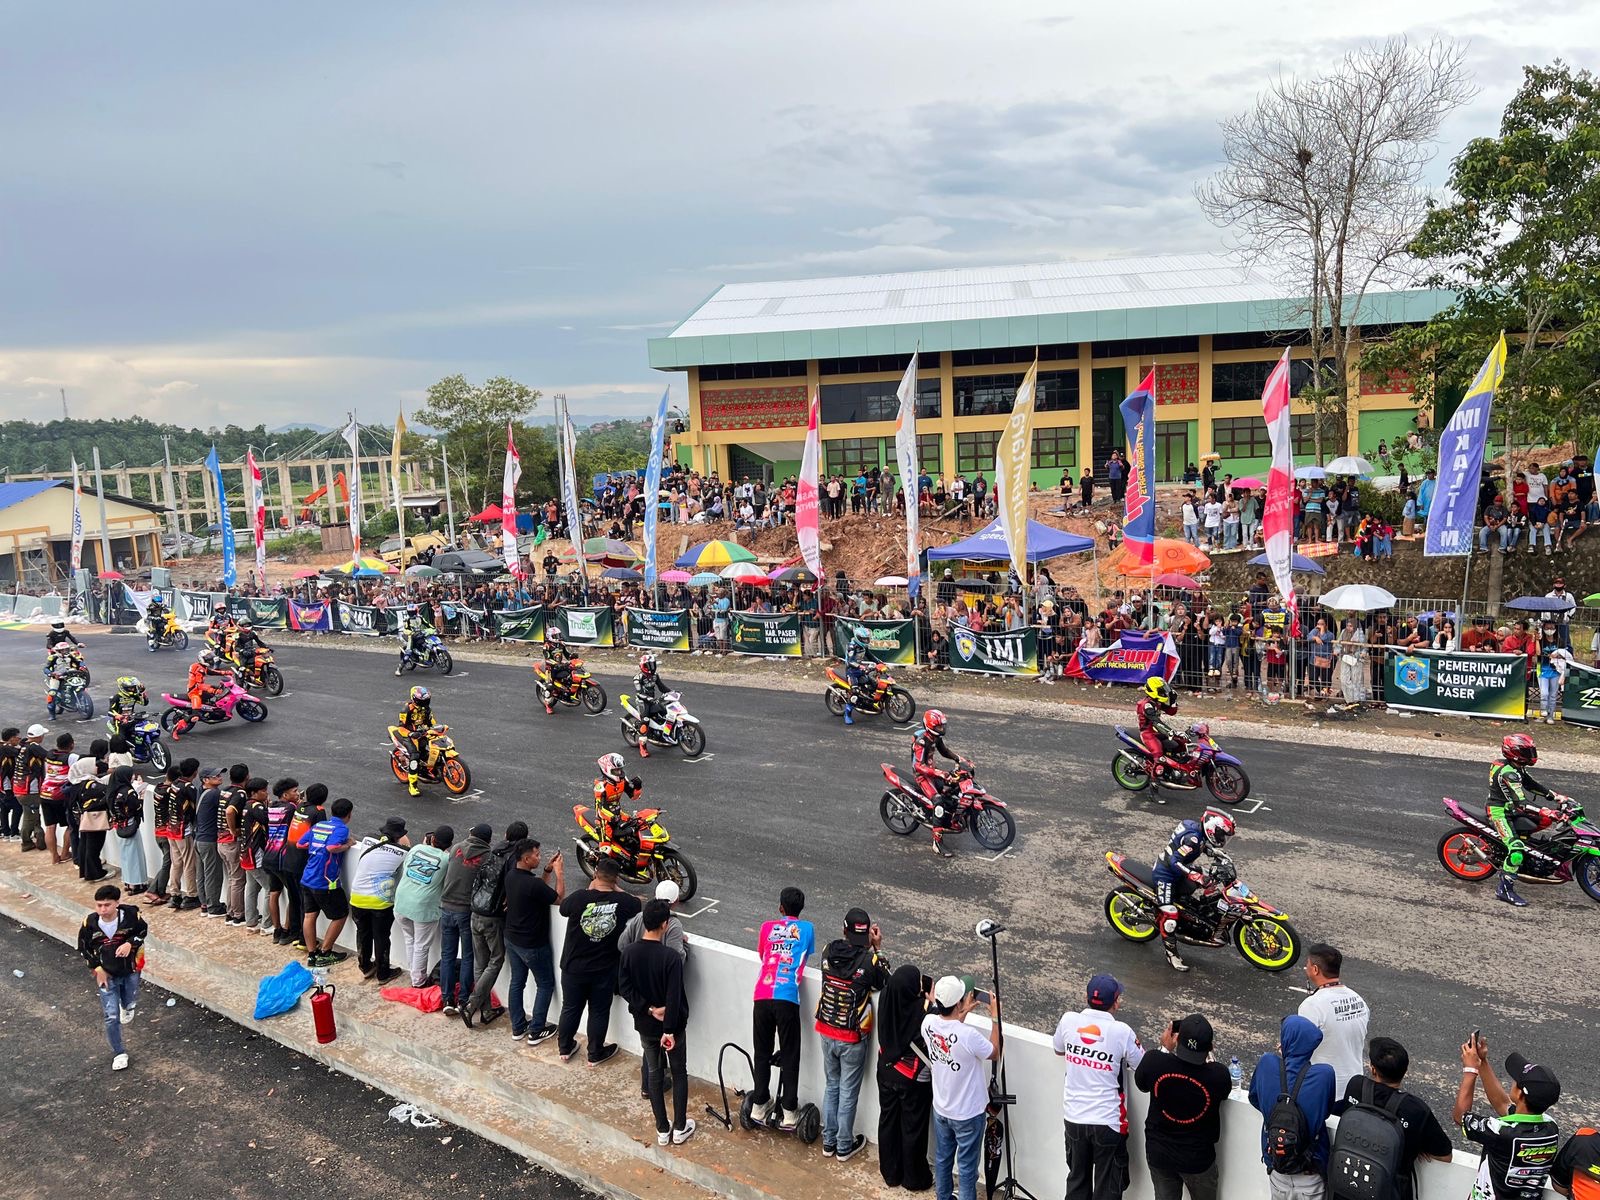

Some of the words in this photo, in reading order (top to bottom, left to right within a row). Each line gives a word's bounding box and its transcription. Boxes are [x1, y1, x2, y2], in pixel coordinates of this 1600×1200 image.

[764, 621, 779, 629] HUT
[984, 638, 1024, 662] IMI
[1127, 662, 1145, 670] PARTS
[1437, 659, 1512, 675] PEMERINTAH
[1437, 673, 1506, 688] KABUPATEN
[1437, 687, 1475, 700] PASER
[583, 902, 596, 917] 2
[592, 902, 618, 914] STROKE
[1066, 1042, 1114, 1063] REPSOL
[1066, 1054, 1113, 1072] HONDA
[1343, 1131, 1391, 1155] crocs
